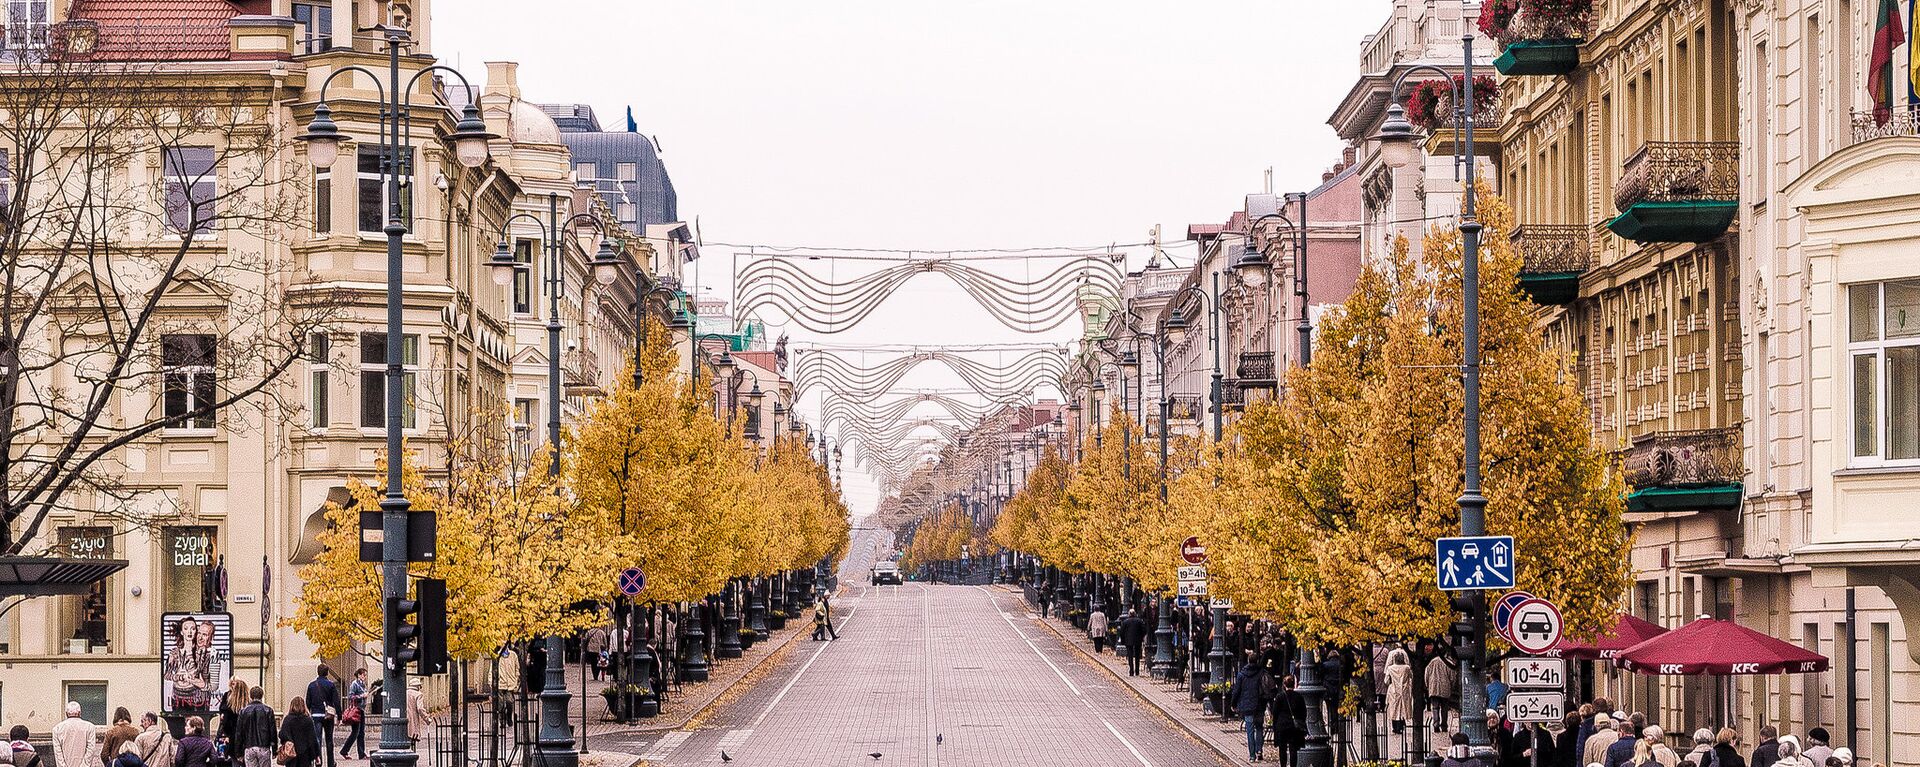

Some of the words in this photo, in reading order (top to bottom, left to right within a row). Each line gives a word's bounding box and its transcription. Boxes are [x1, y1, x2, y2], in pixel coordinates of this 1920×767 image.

[175, 550, 209, 566] batai
[1546, 649, 1563, 658] KFC
[1599, 649, 1617, 658] KF
[1659, 664, 1684, 674] KFC
[1731, 662, 1760, 674] KFC
[1800, 661, 1817, 672] KFC
